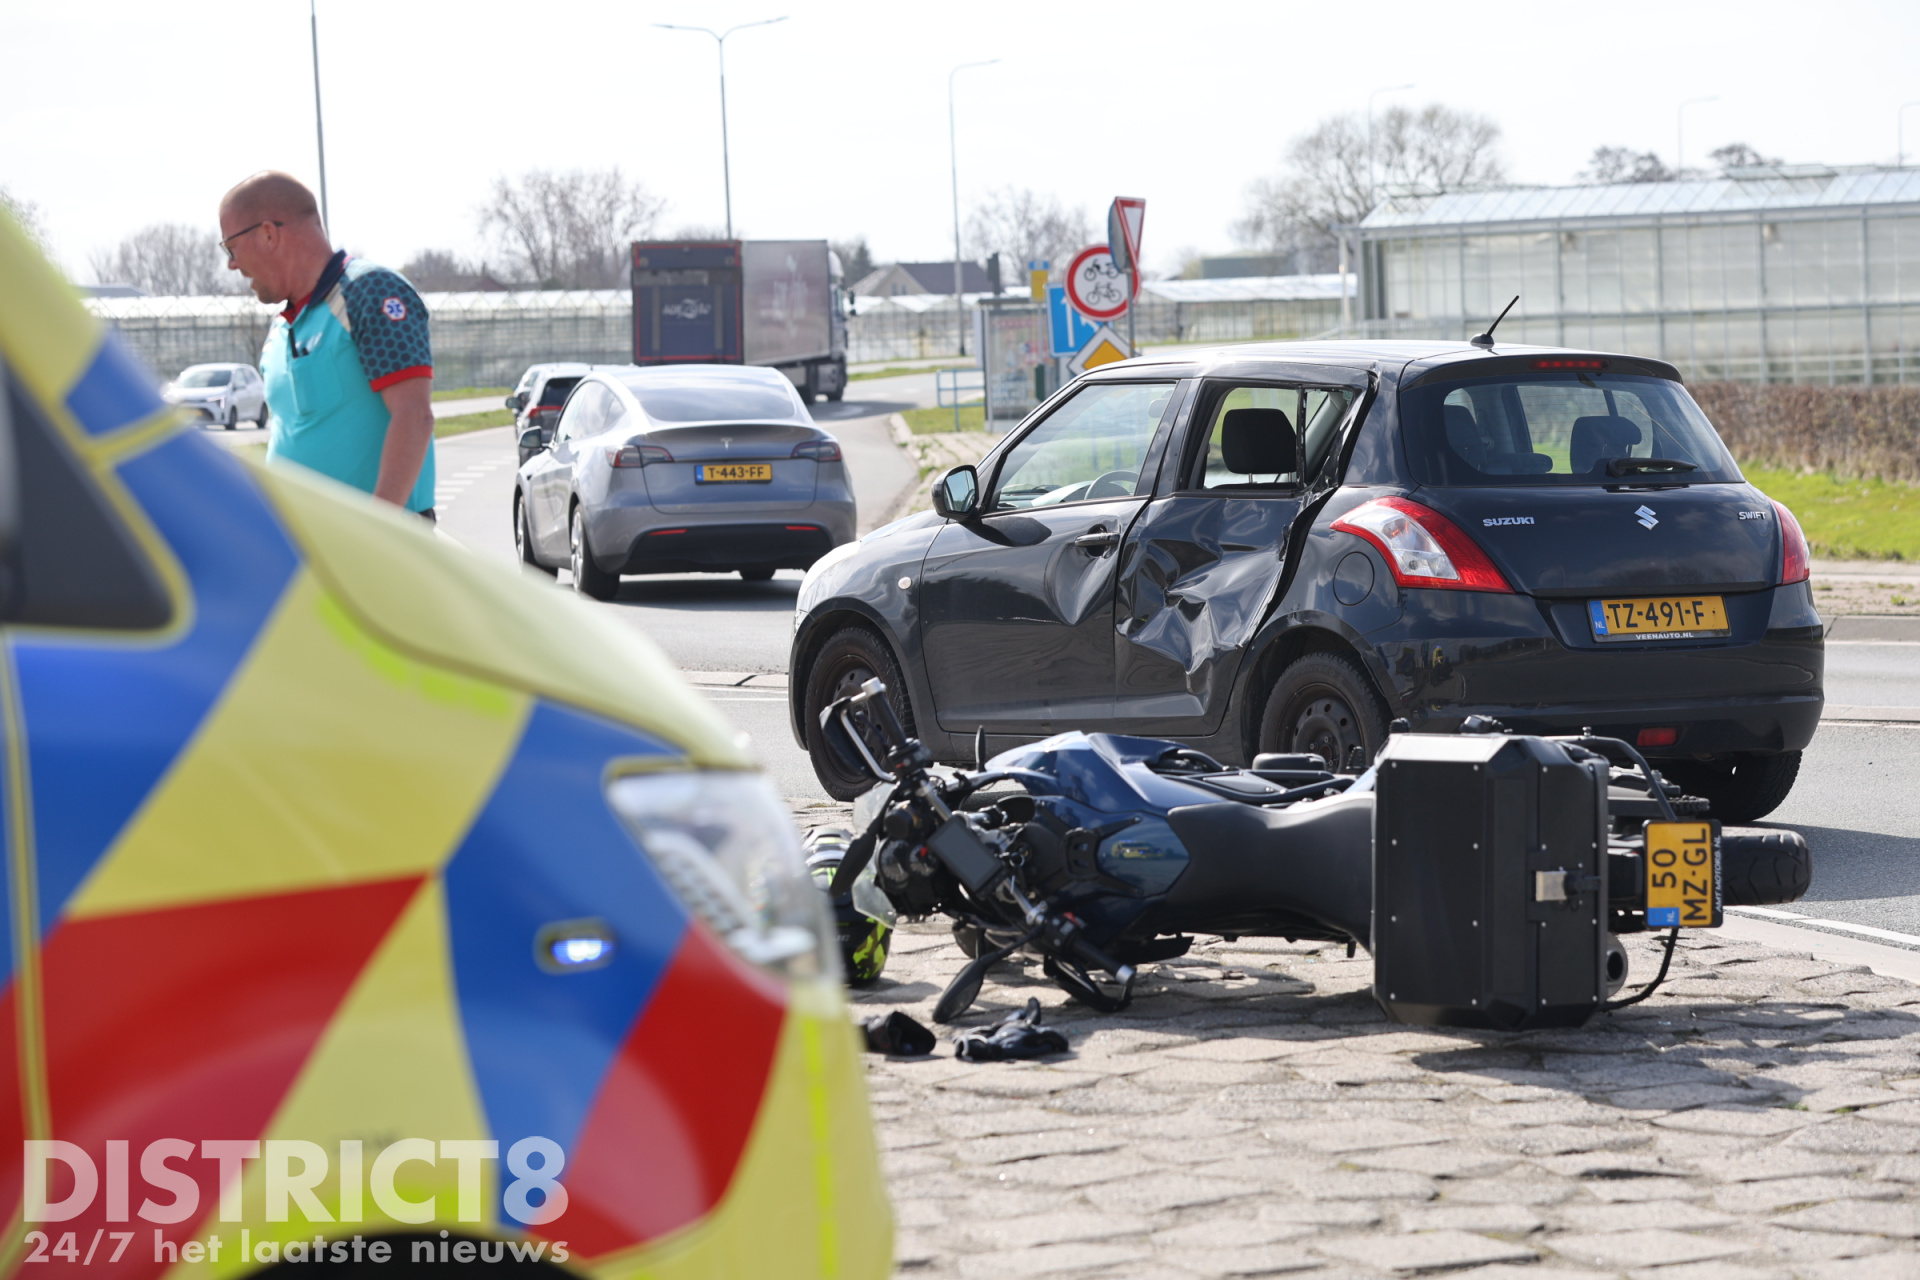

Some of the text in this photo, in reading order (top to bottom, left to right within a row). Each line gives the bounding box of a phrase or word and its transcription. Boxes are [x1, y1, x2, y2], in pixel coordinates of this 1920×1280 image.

[708, 466, 764, 479] T-443-FF
[1483, 516, 1535, 527] SUZUKI
[1738, 510, 1767, 521] SWIFT
[1595, 600, 1705, 630] NL TZ-491-F
[1635, 632, 1694, 640] VEENAUTO.NL
[1652, 849, 1677, 888] 50
